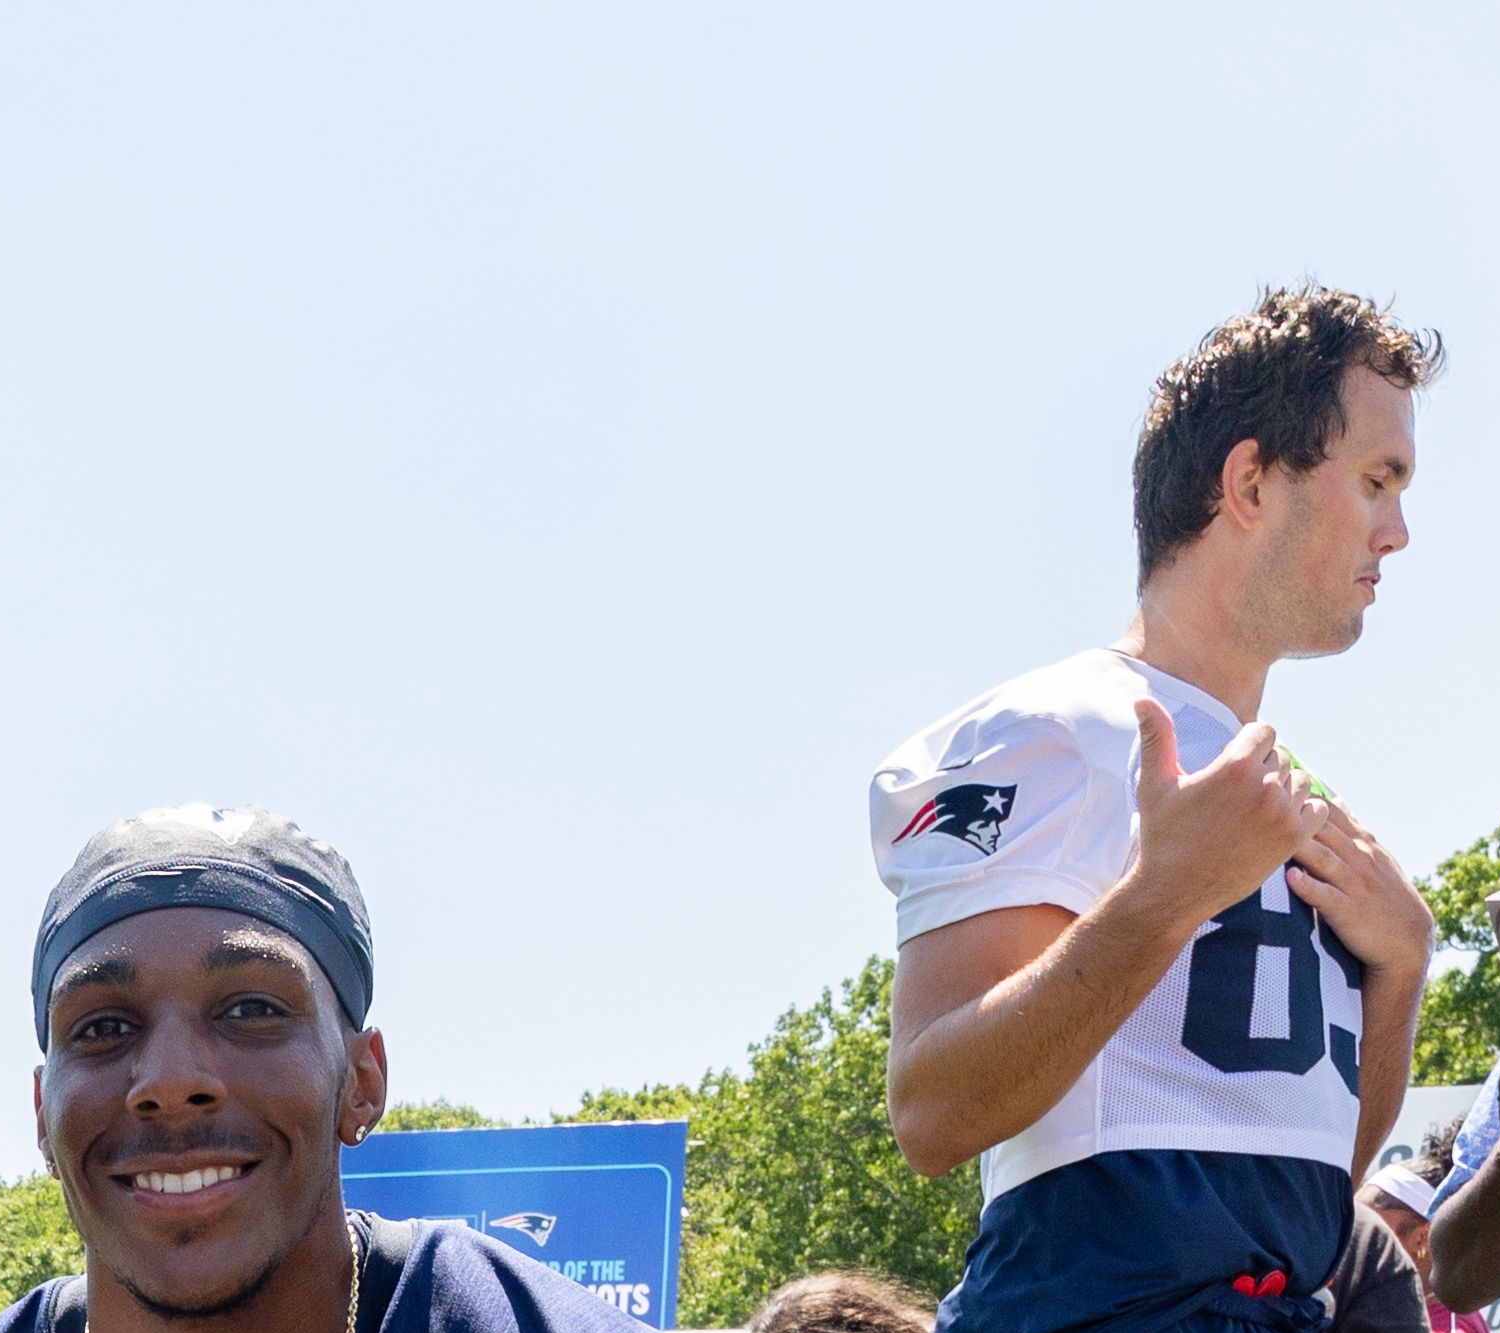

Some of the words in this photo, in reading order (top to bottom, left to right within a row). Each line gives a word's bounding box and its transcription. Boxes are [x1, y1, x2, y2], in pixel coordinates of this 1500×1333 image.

[1182, 857, 1364, 1099] 8
[564, 1260, 587, 1281] OF
[591, 1259, 625, 1281] THE
[588, 1284, 650, 1316] OTS
